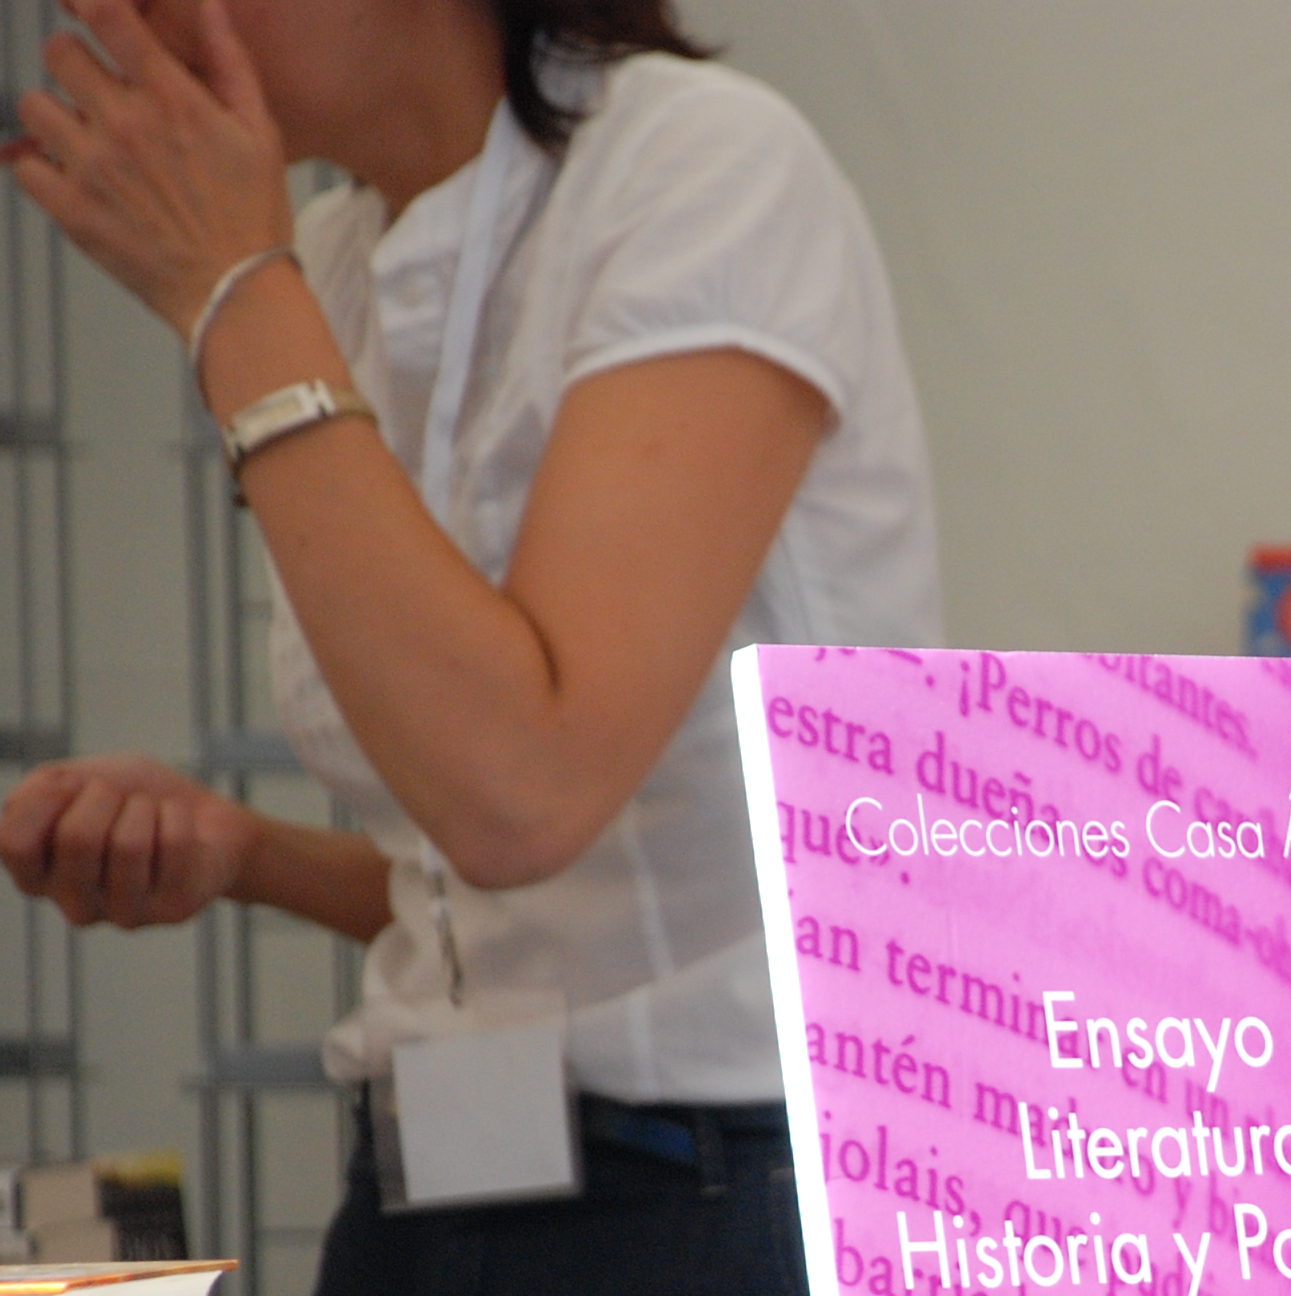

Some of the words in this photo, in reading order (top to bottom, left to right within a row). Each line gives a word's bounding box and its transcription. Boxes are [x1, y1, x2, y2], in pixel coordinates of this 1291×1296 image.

[845, 793, 1131, 857] Colecciones
[1145, 799, 1266, 858] Casa
[1042, 990, 1274, 1093] Ensayo
[896, 1210, 1152, 1290] Historia
